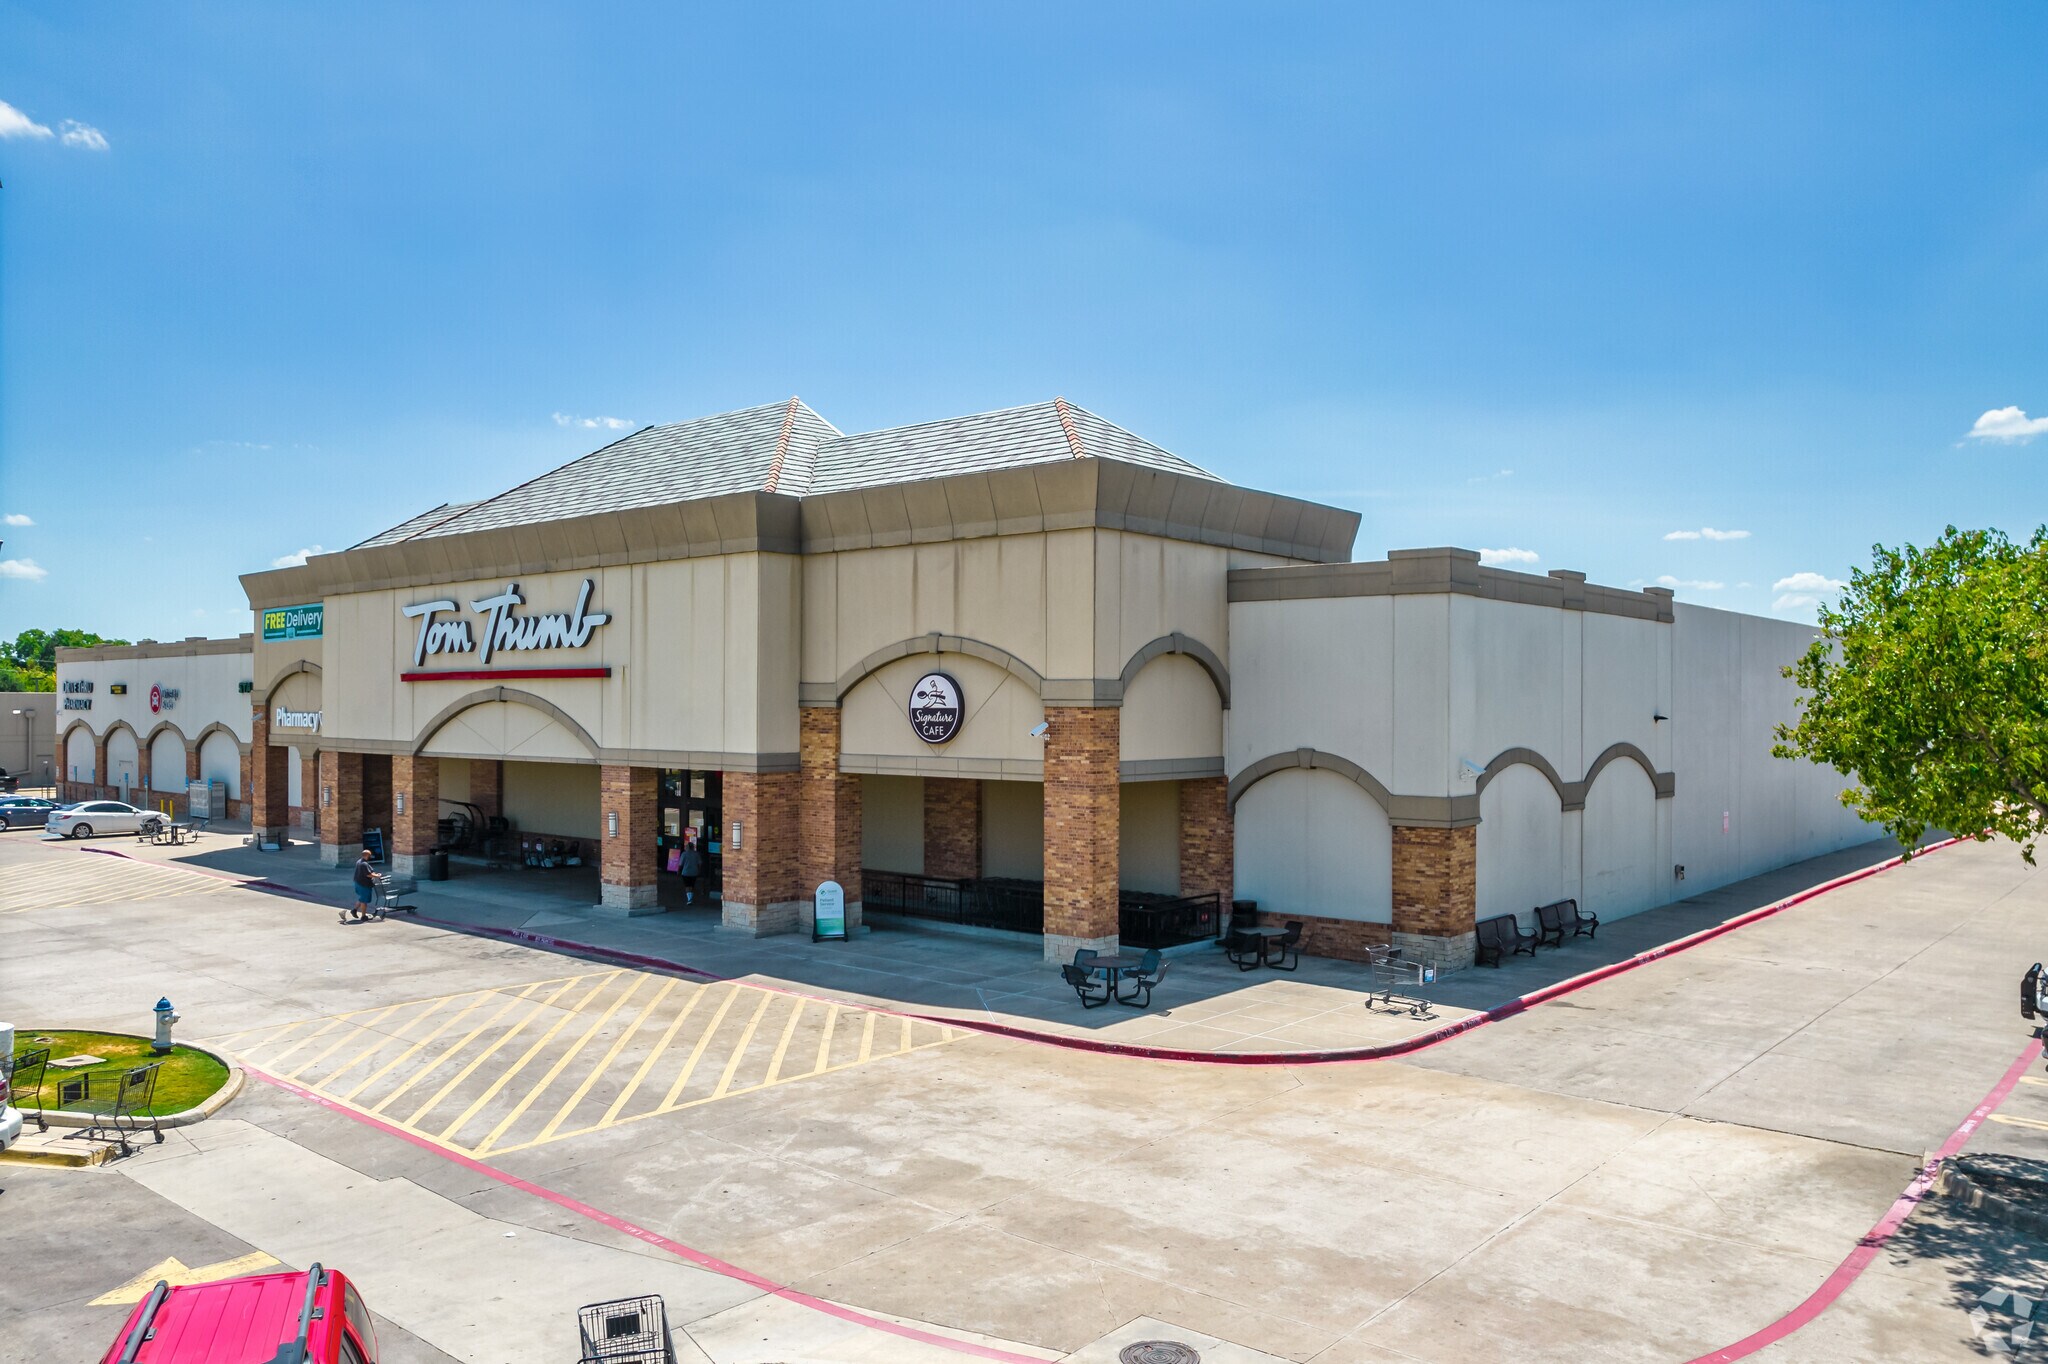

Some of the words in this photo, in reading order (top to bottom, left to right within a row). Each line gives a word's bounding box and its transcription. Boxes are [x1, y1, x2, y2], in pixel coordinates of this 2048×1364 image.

[265, 611, 286, 629] FREE
[286, 609, 323, 629] Delivery
[402, 600, 476, 667] Tom
[469, 578, 612, 664] Thumb
[276, 706, 320, 732] Pharmacy
[914, 709, 954, 726] Signature
[922, 725, 944, 736] CAFE
